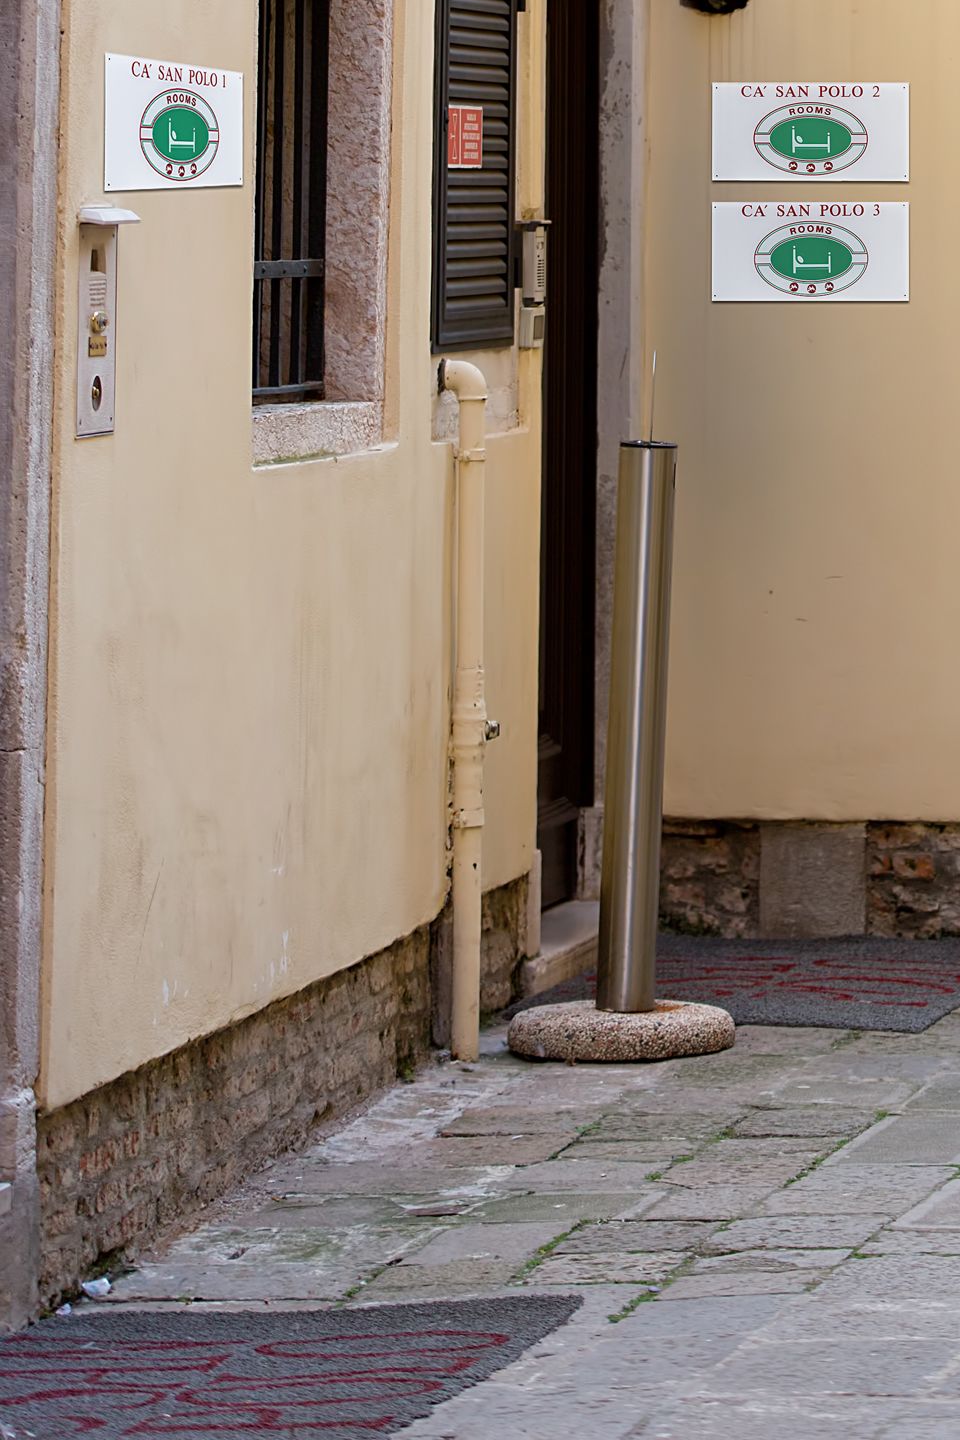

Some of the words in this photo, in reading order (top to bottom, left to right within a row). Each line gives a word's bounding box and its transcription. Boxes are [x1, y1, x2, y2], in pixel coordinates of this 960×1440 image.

[131, 60, 153, 79] CA'
[157, 65, 183, 82] SAN
[188, 70, 218, 87] POLO
[222, 74, 227, 89] 1
[740, 85, 767, 98] CA'
[775, 85, 810, 98] SAN
[817, 85, 864, 98] POLO
[872, 85, 881, 98] 2
[166, 93, 198, 107] ROOMS
[788, 105, 832, 116] ROOMS
[741, 204, 768, 218] CA'
[776, 204, 811, 218] SAN
[819, 203, 865, 217] POLO
[872, 203, 881, 217] 3
[789, 224, 833, 236] ROOMS
